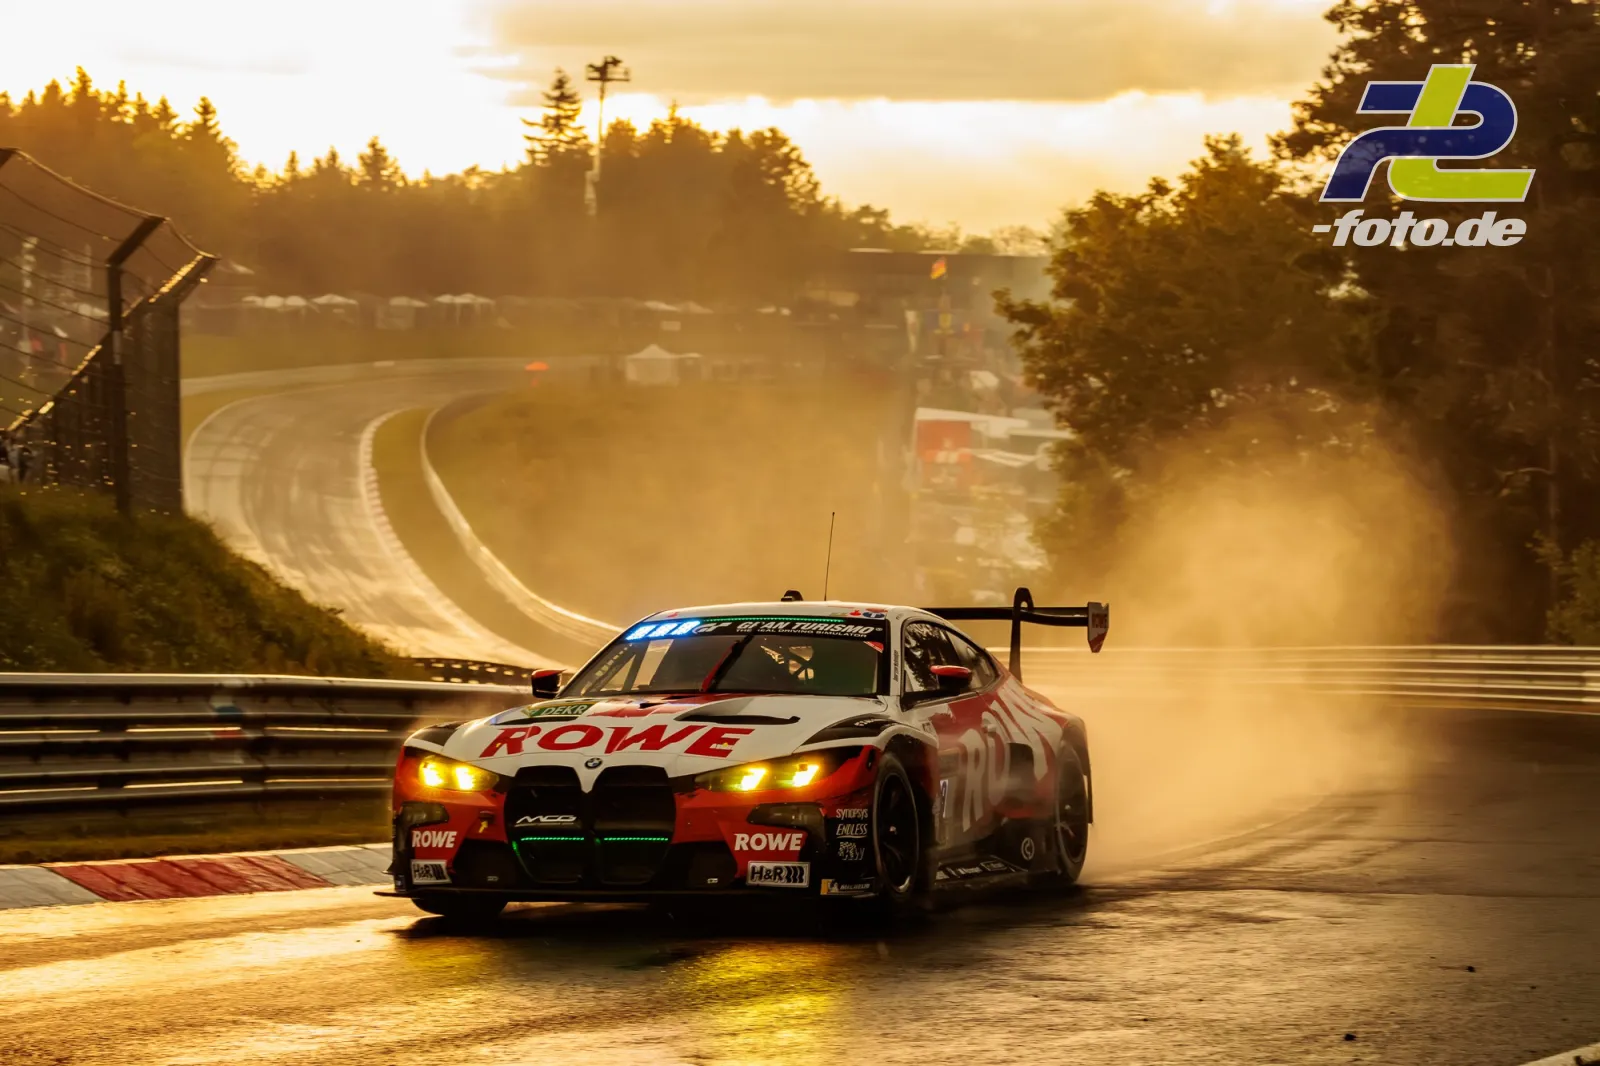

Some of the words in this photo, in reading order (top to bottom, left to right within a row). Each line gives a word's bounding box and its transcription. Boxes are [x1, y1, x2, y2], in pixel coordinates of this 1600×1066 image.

[791, 622, 875, 635] TURISMO
[479, 724, 756, 759] ROWE
[836, 823, 868, 836] ENDLESS
[412, 830, 458, 848] ROWE
[734, 832, 803, 851] ROWE
[750, 865, 784, 882] H&R
